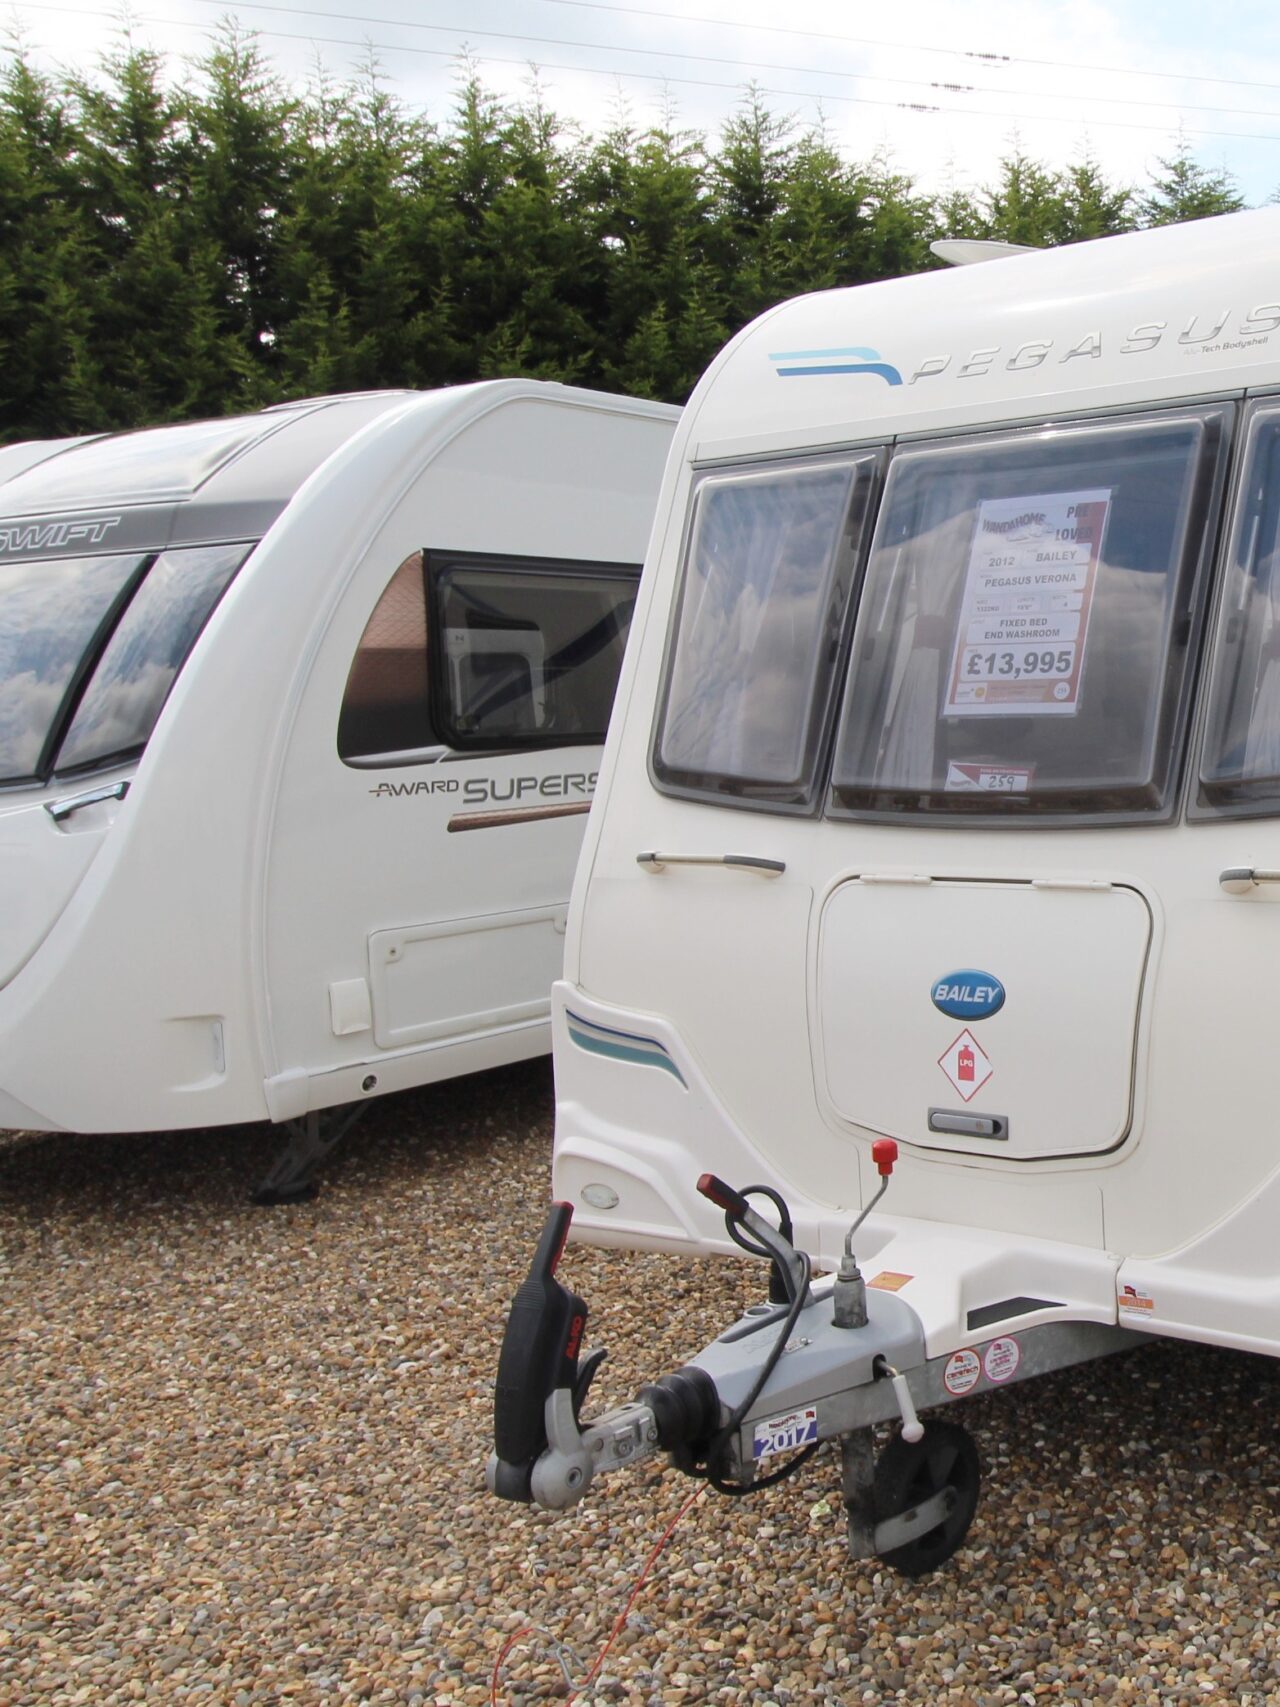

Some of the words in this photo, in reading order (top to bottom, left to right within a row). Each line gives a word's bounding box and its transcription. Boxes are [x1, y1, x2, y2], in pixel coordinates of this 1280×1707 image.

[1222, 336, 1269, 350] Bodyshell
[1066, 505, 1090, 519] PRE
[981, 511, 1047, 534] WANDAHOME
[1055, 526, 1094, 541] LOVED
[988, 556, 1015, 567] 2012
[1035, 550, 1077, 562] BAILEY
[984, 575, 1031, 588] PEGASUS
[1034, 573, 1077, 584] VERONA
[999, 618, 1028, 627] FIXED
[1030, 617, 1048, 627] BED
[984, 630, 1004, 640] END
[1005, 628, 1060, 639] WASHROOM
[967, 650, 1072, 679] £13,995
[369, 779, 459, 798] AWARD
[988, 774, 1015, 792] 259
[934, 984, 1000, 1004] BAILEY
[960, 1059, 973, 1068] LPG
[760, 1421, 811, 1457] 2017
